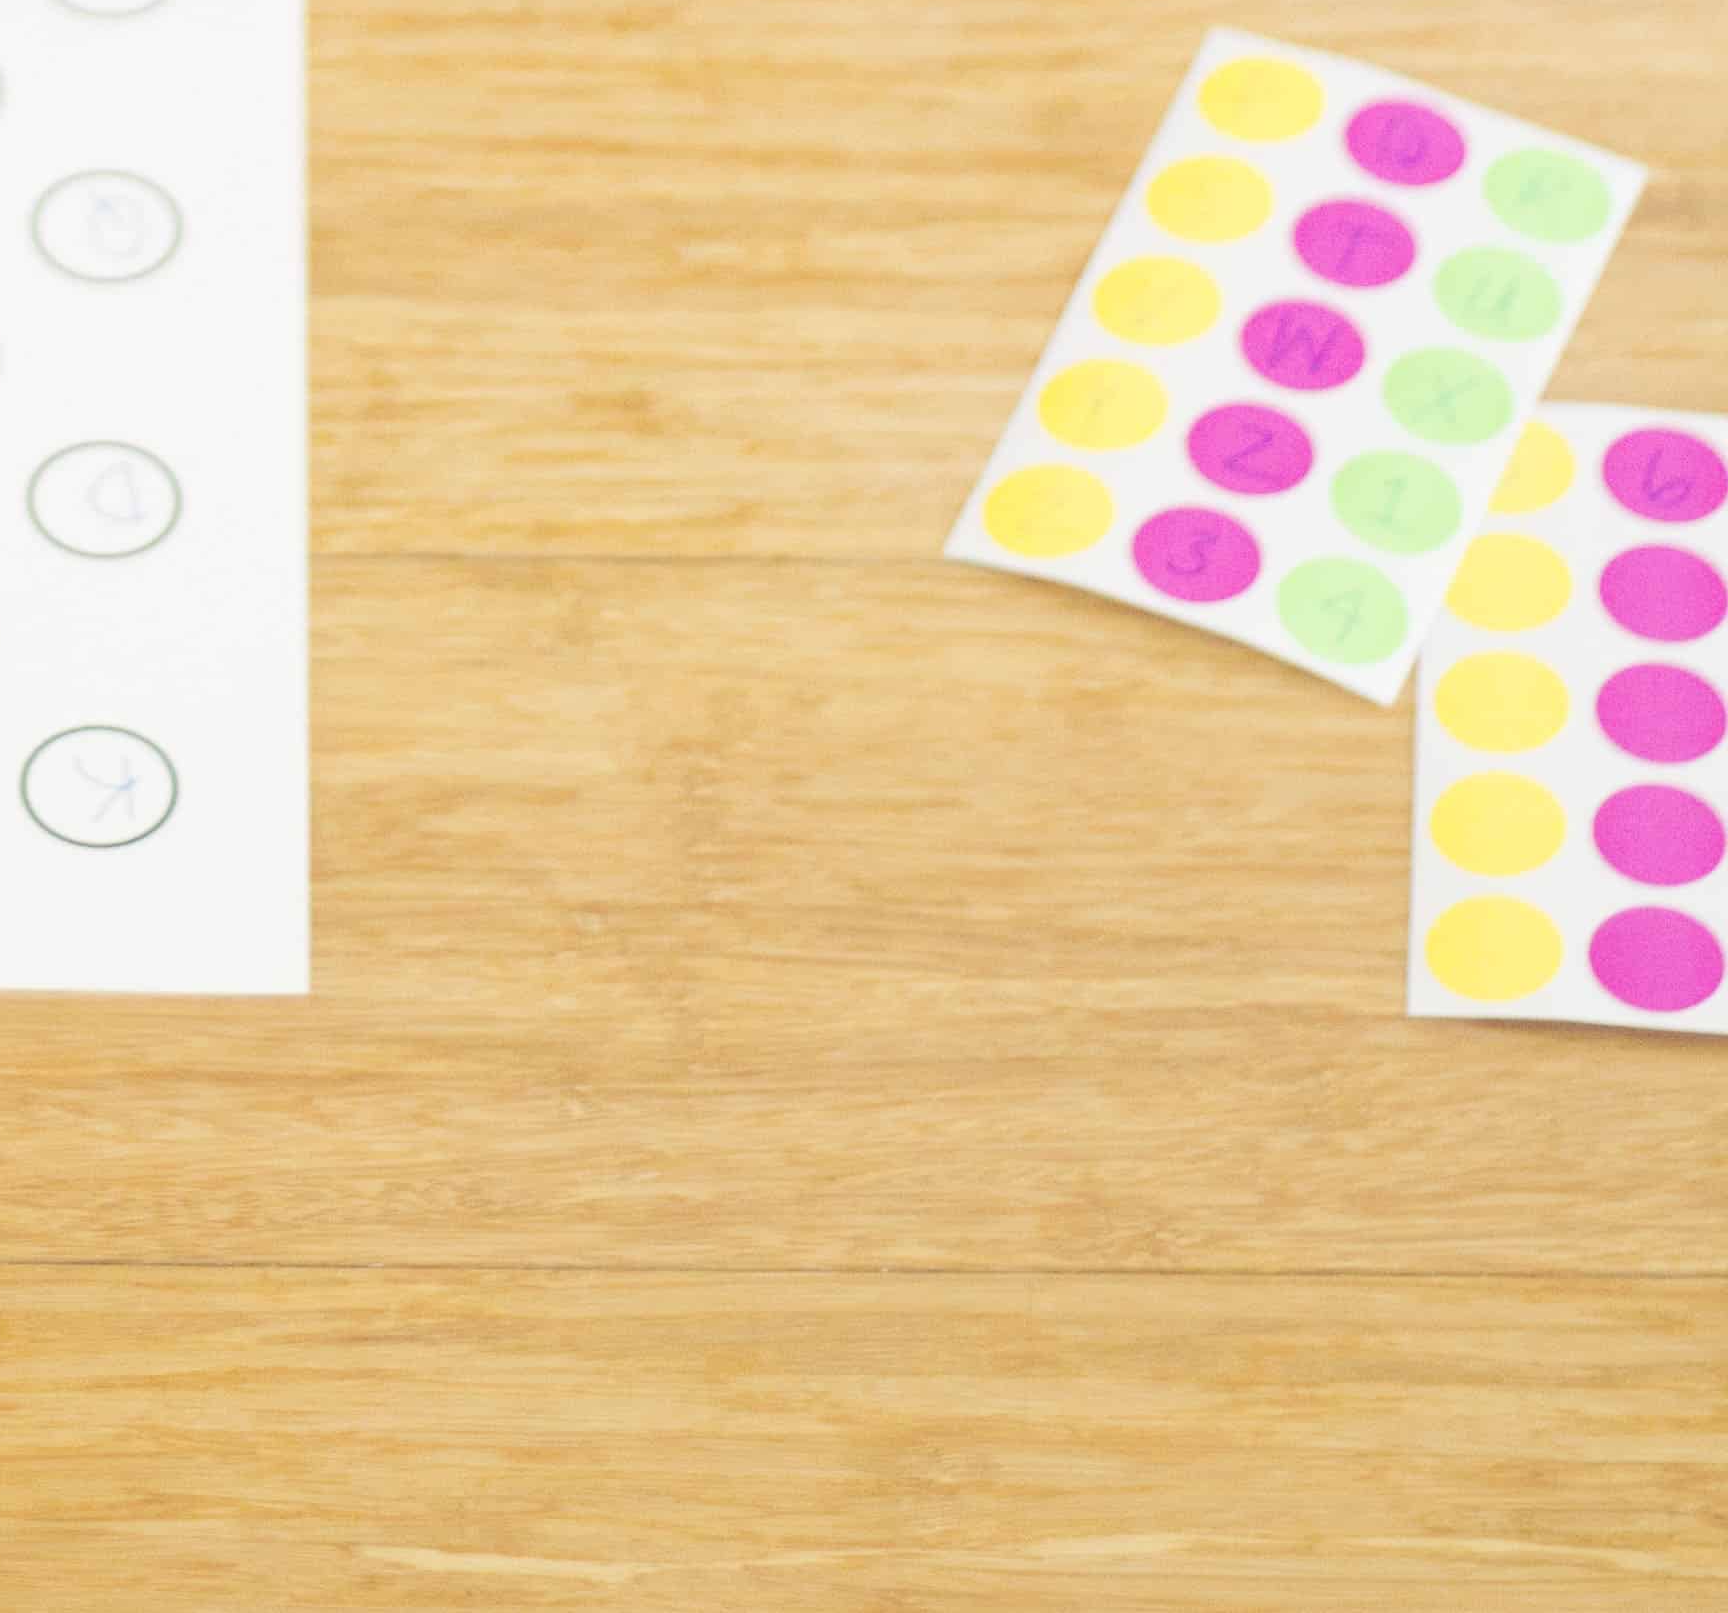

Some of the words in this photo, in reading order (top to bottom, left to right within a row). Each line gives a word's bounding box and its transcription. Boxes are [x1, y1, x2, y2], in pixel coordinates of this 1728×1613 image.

[1267, 311, 1343, 376] W
[1409, 367, 1480, 426] X
[84, 459, 146, 527] D
[1640, 447, 1692, 505] 6
[1165, 529, 1219, 579] 3
[1319, 586, 1368, 646] 4
[72, 754, 140, 825] K
